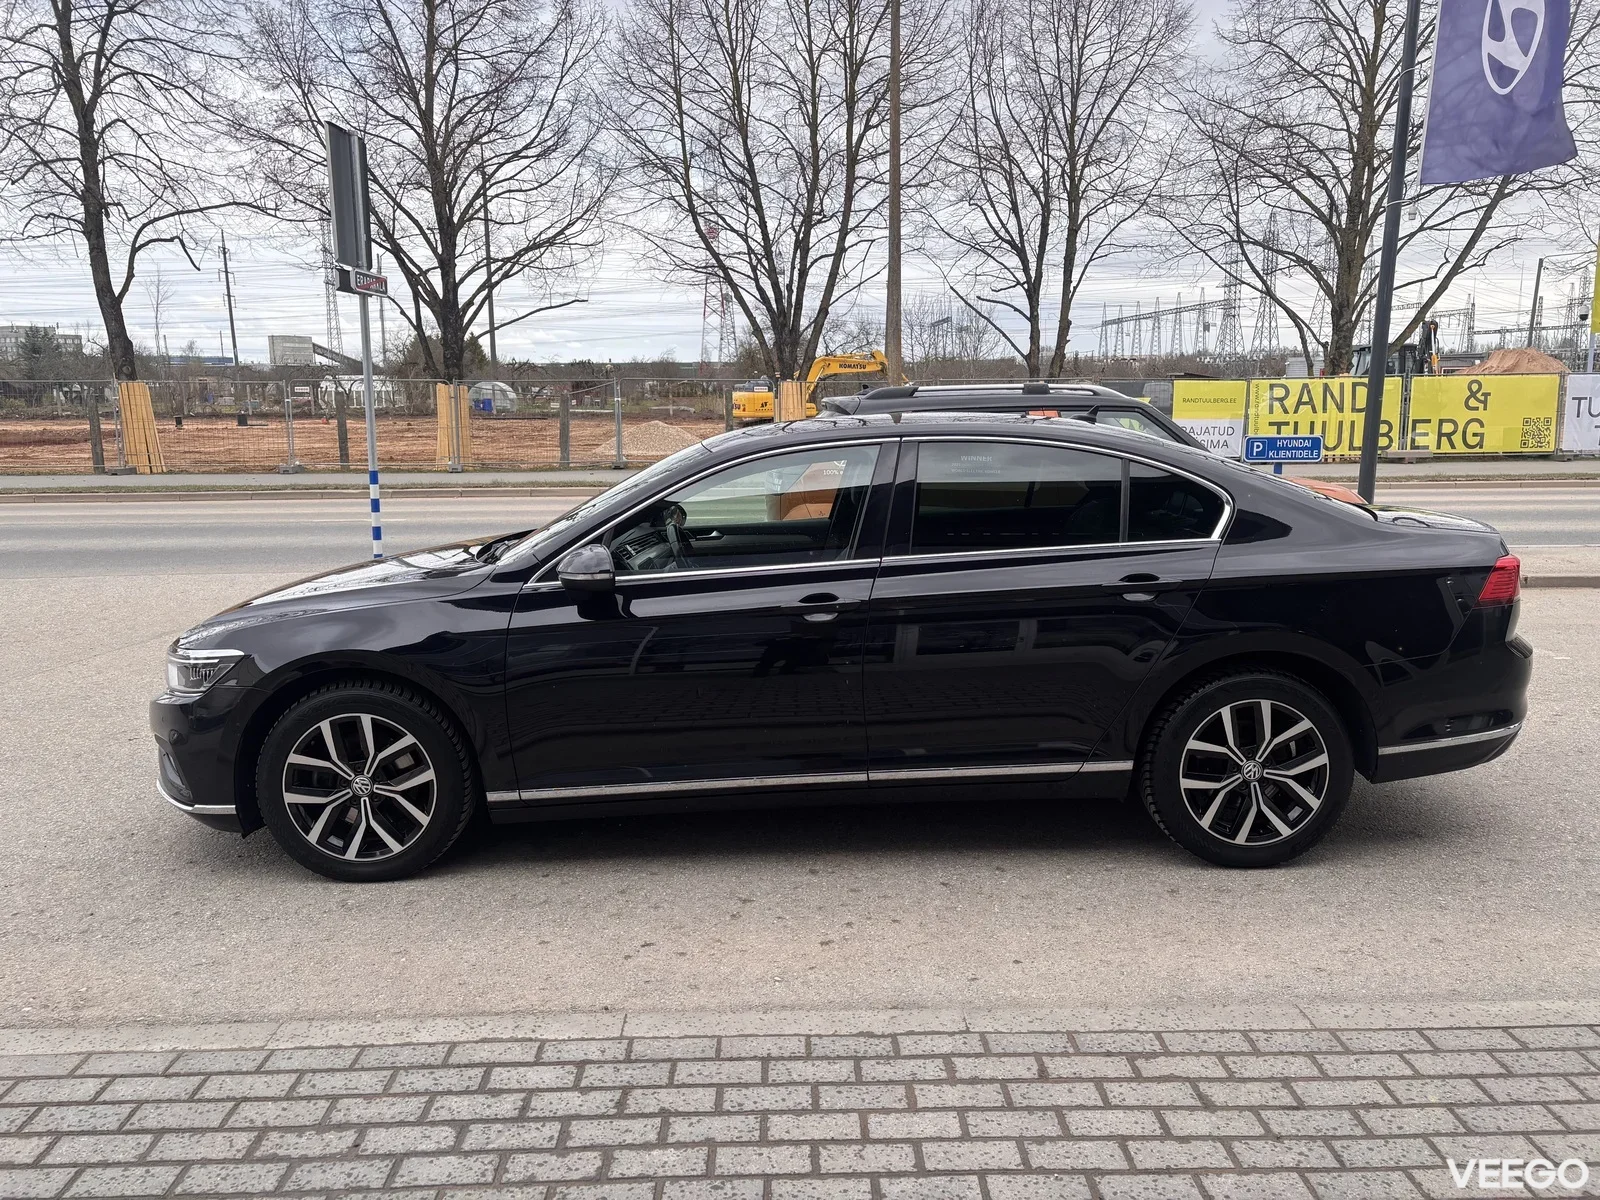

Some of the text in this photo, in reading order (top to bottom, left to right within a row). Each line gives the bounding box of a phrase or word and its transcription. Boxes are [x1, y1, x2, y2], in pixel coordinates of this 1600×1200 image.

[1268, 379, 1491, 414] RAND &
[1195, 436, 1229, 449] SIMA
[1277, 439, 1312, 448] HYUNDAI
[1268, 450, 1319, 459] KLIENTIDELE
